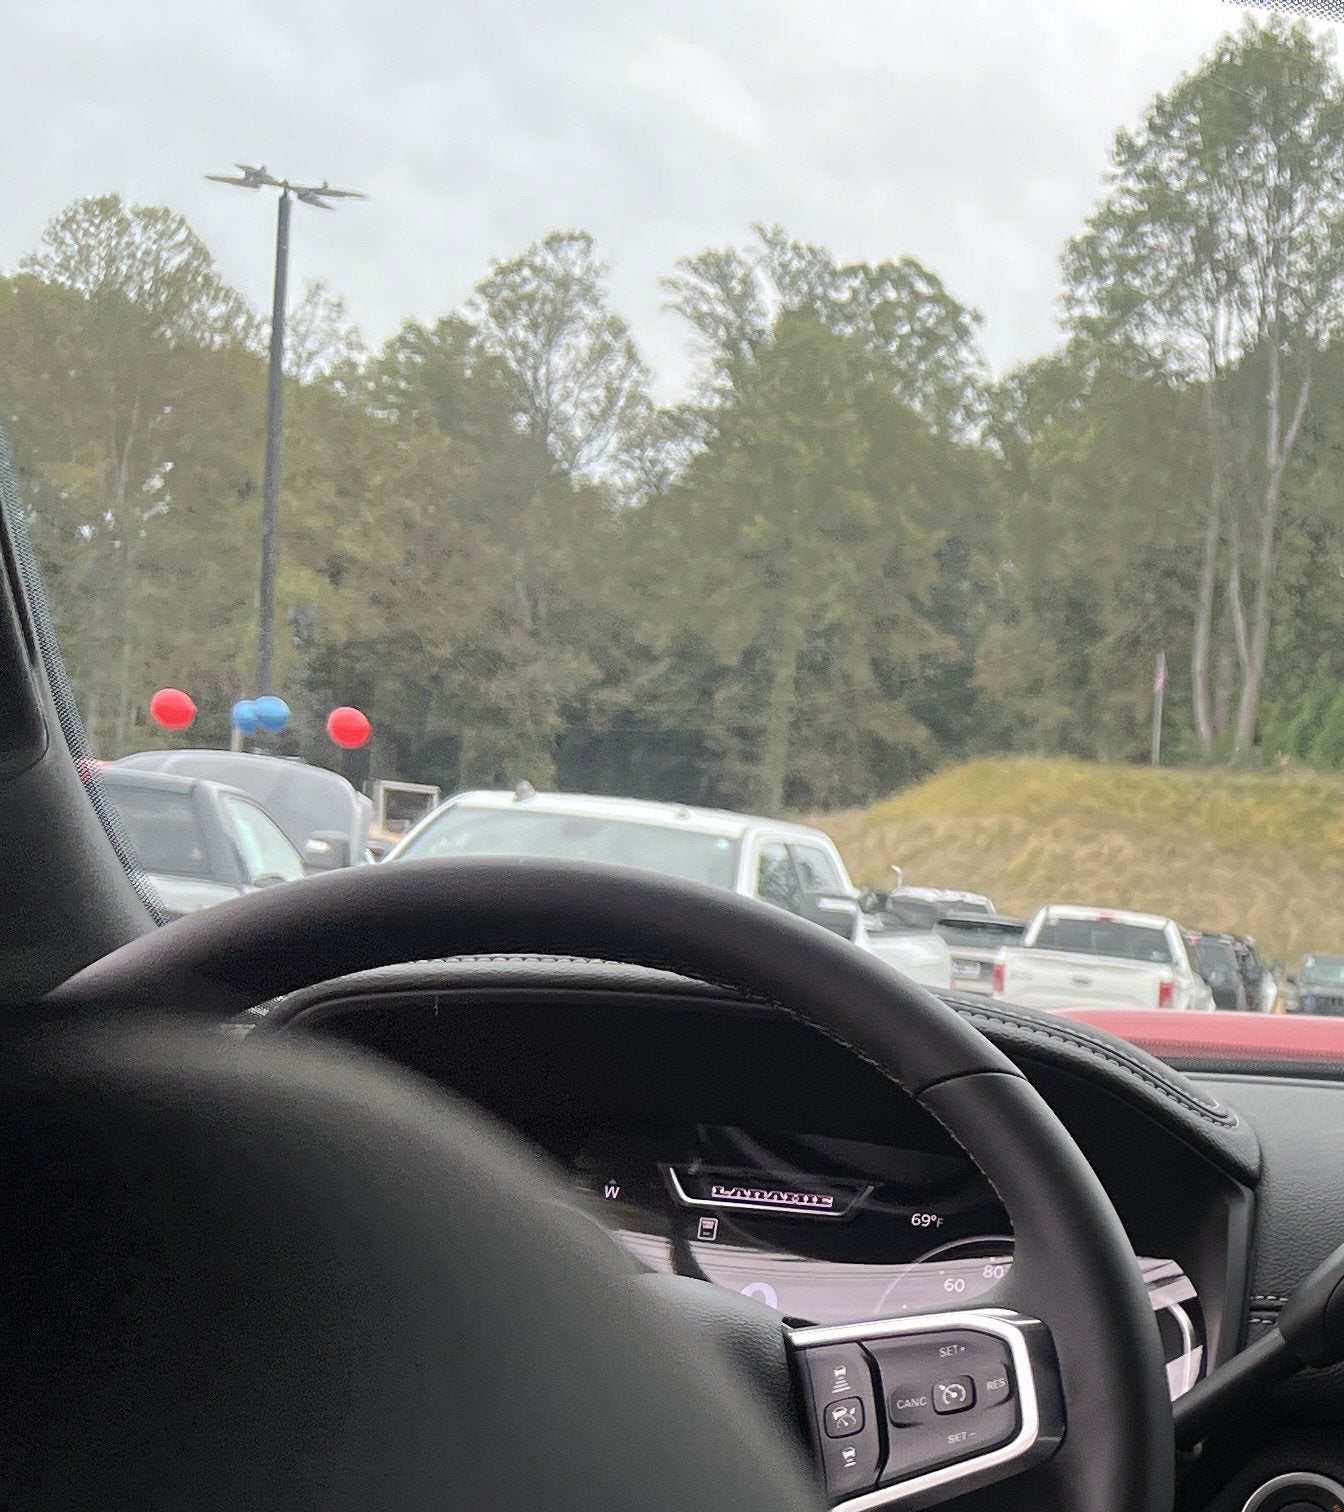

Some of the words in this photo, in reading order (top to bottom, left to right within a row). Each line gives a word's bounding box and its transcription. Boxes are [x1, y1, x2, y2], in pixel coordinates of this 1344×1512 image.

[604, 1184, 620, 1199] W
[982, 1265, 1004, 1279] 80
[943, 1278, 965, 1292] 60
[986, 1378, 1006, 1391] RES
[896, 1396, 927, 1409] CANC
